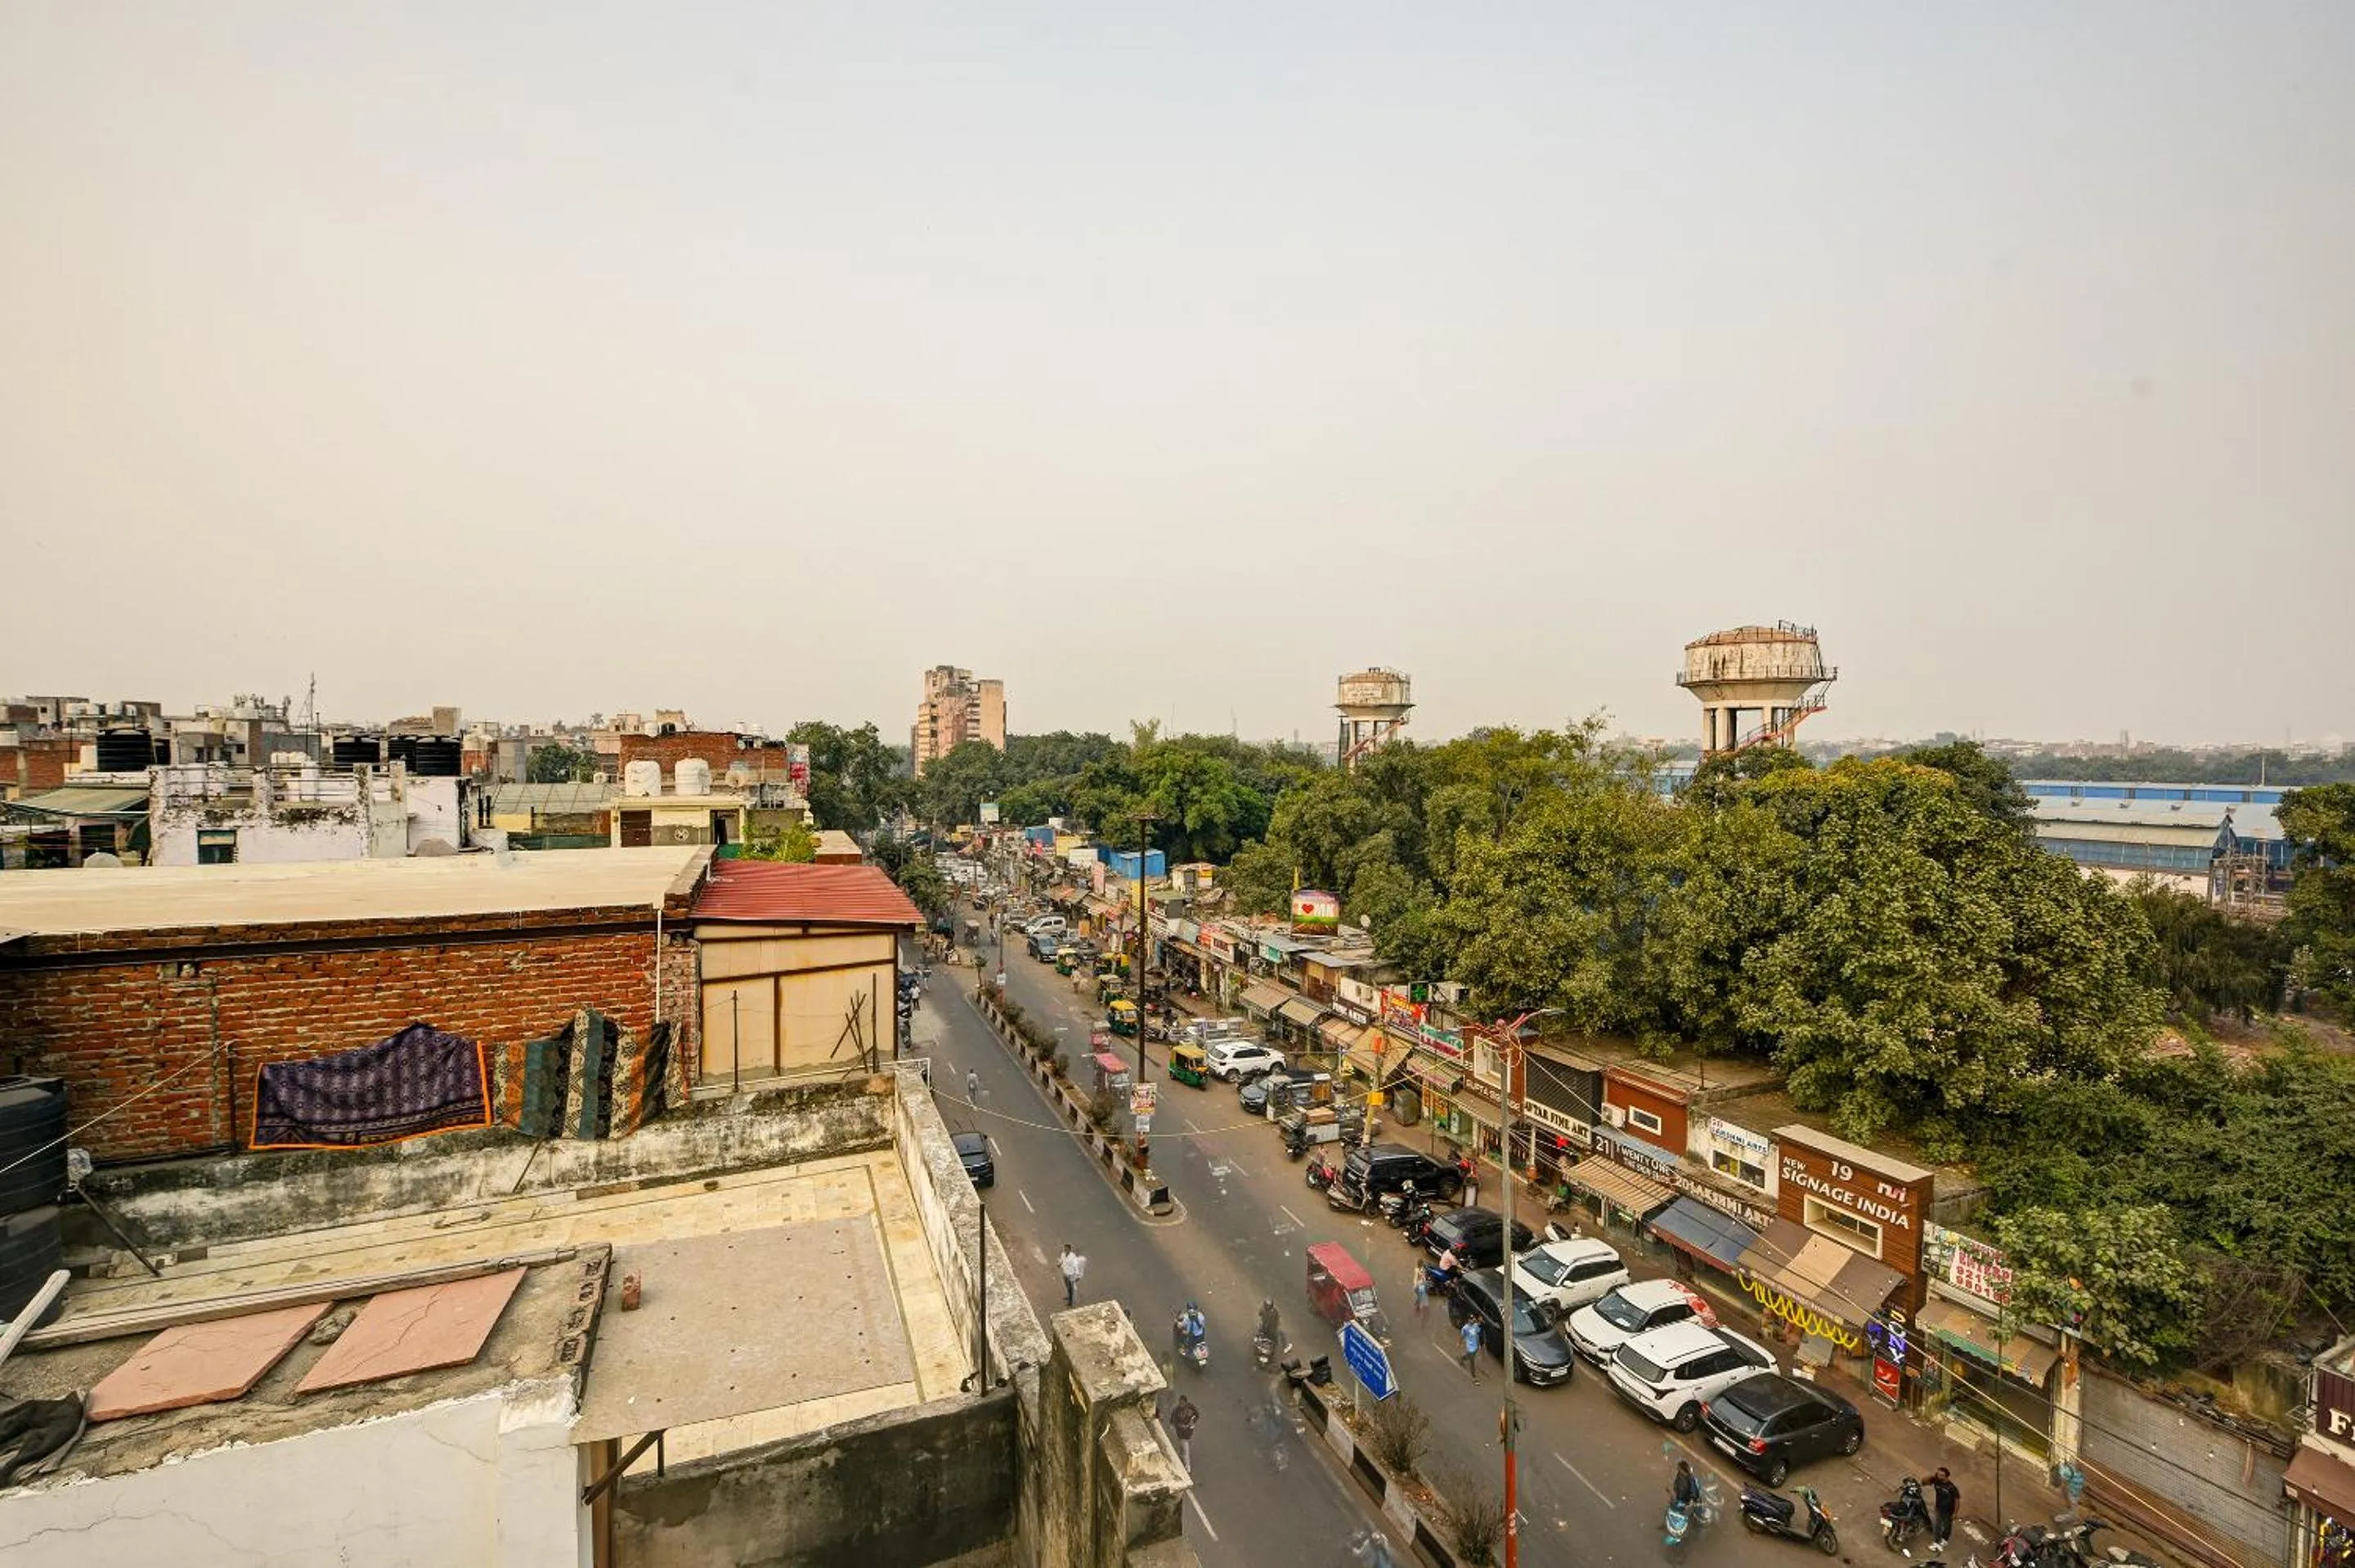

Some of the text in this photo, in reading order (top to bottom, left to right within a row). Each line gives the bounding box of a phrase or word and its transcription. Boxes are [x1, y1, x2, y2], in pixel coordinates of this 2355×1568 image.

[1550, 1112, 1569, 1131] FINE
[1572, 1122, 1589, 1139] ART
[1595, 1136, 1609, 1154] 21
[1783, 1156, 1806, 1170] NEW
[1831, 1161, 1854, 1181] 19
[1781, 1167, 1909, 1230] SIGNAGE INDIA
